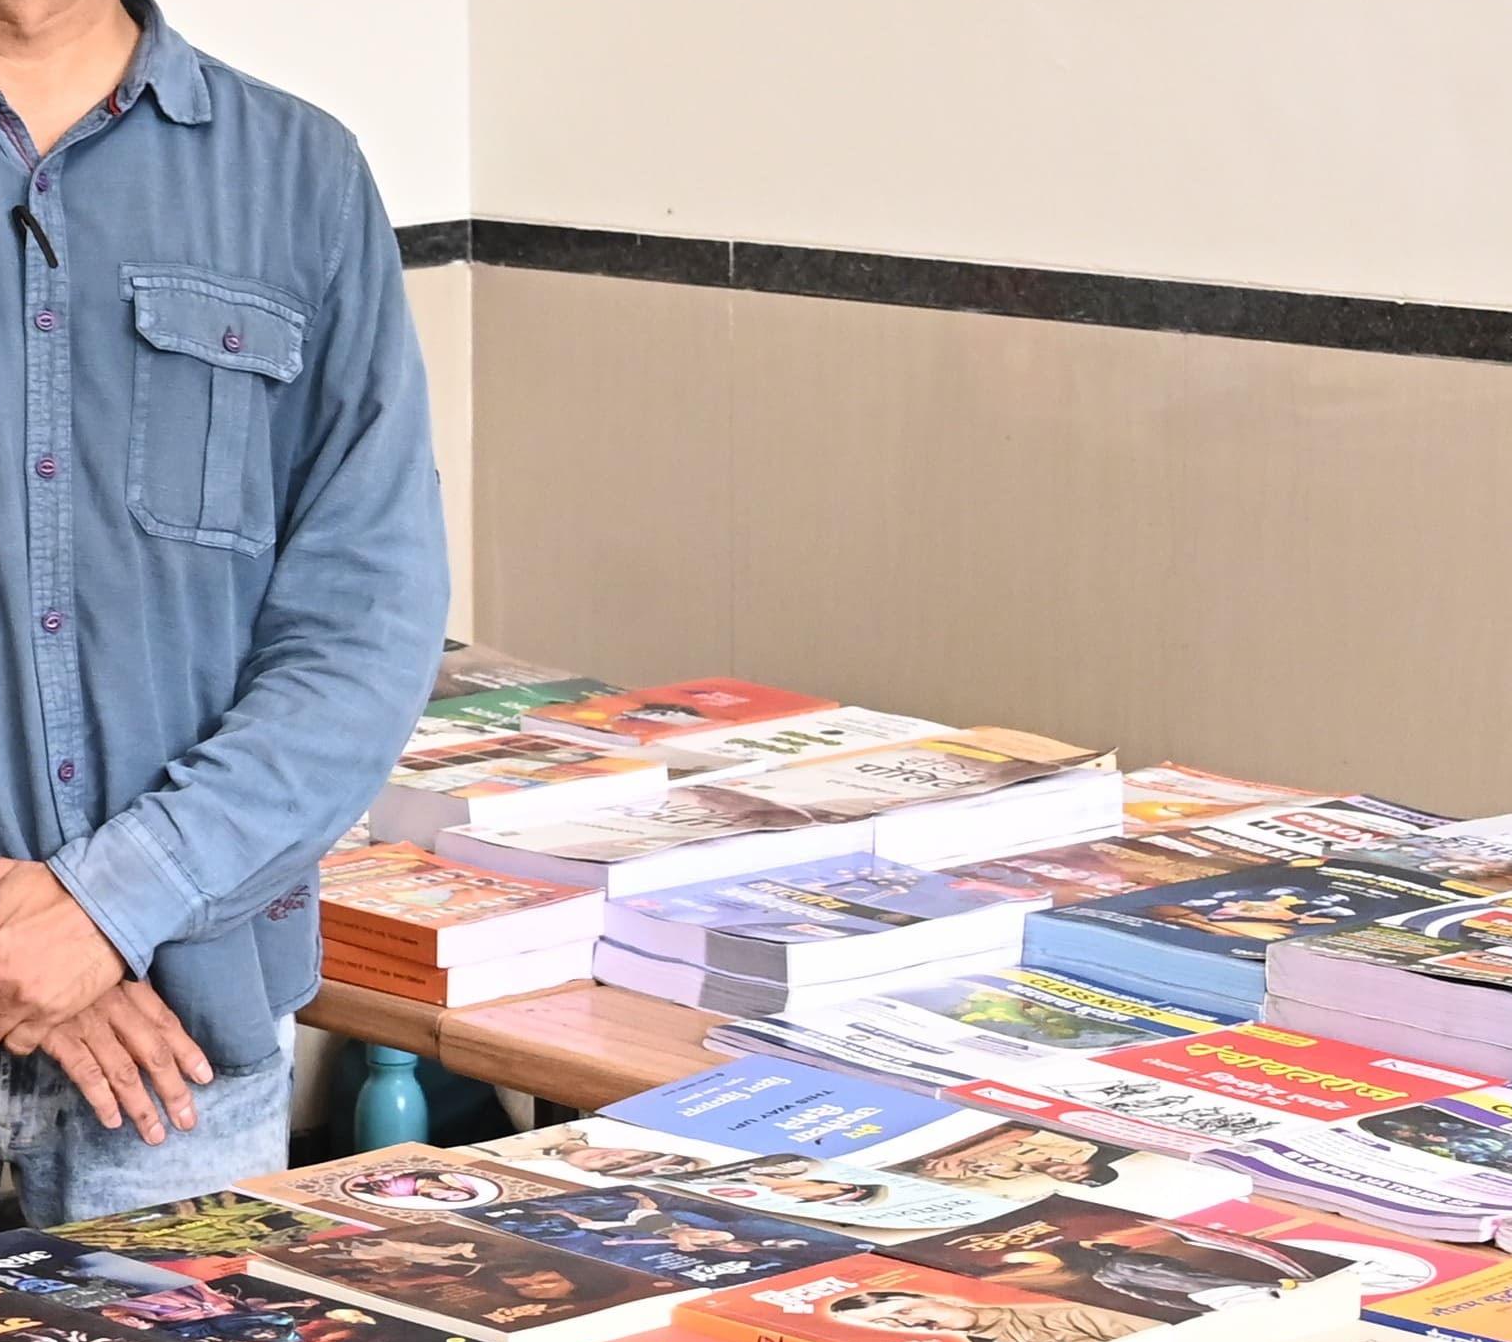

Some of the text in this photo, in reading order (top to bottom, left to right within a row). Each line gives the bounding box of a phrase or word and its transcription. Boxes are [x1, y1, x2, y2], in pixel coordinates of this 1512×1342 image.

[1288, 812, 1387, 845] Notes
[1029, 977, 1092, 1002] CLASS
[1091, 994, 1162, 1019] NOTES
[796, 1087, 836, 1104] THIS
[757, 1102, 792, 1121] WAY
